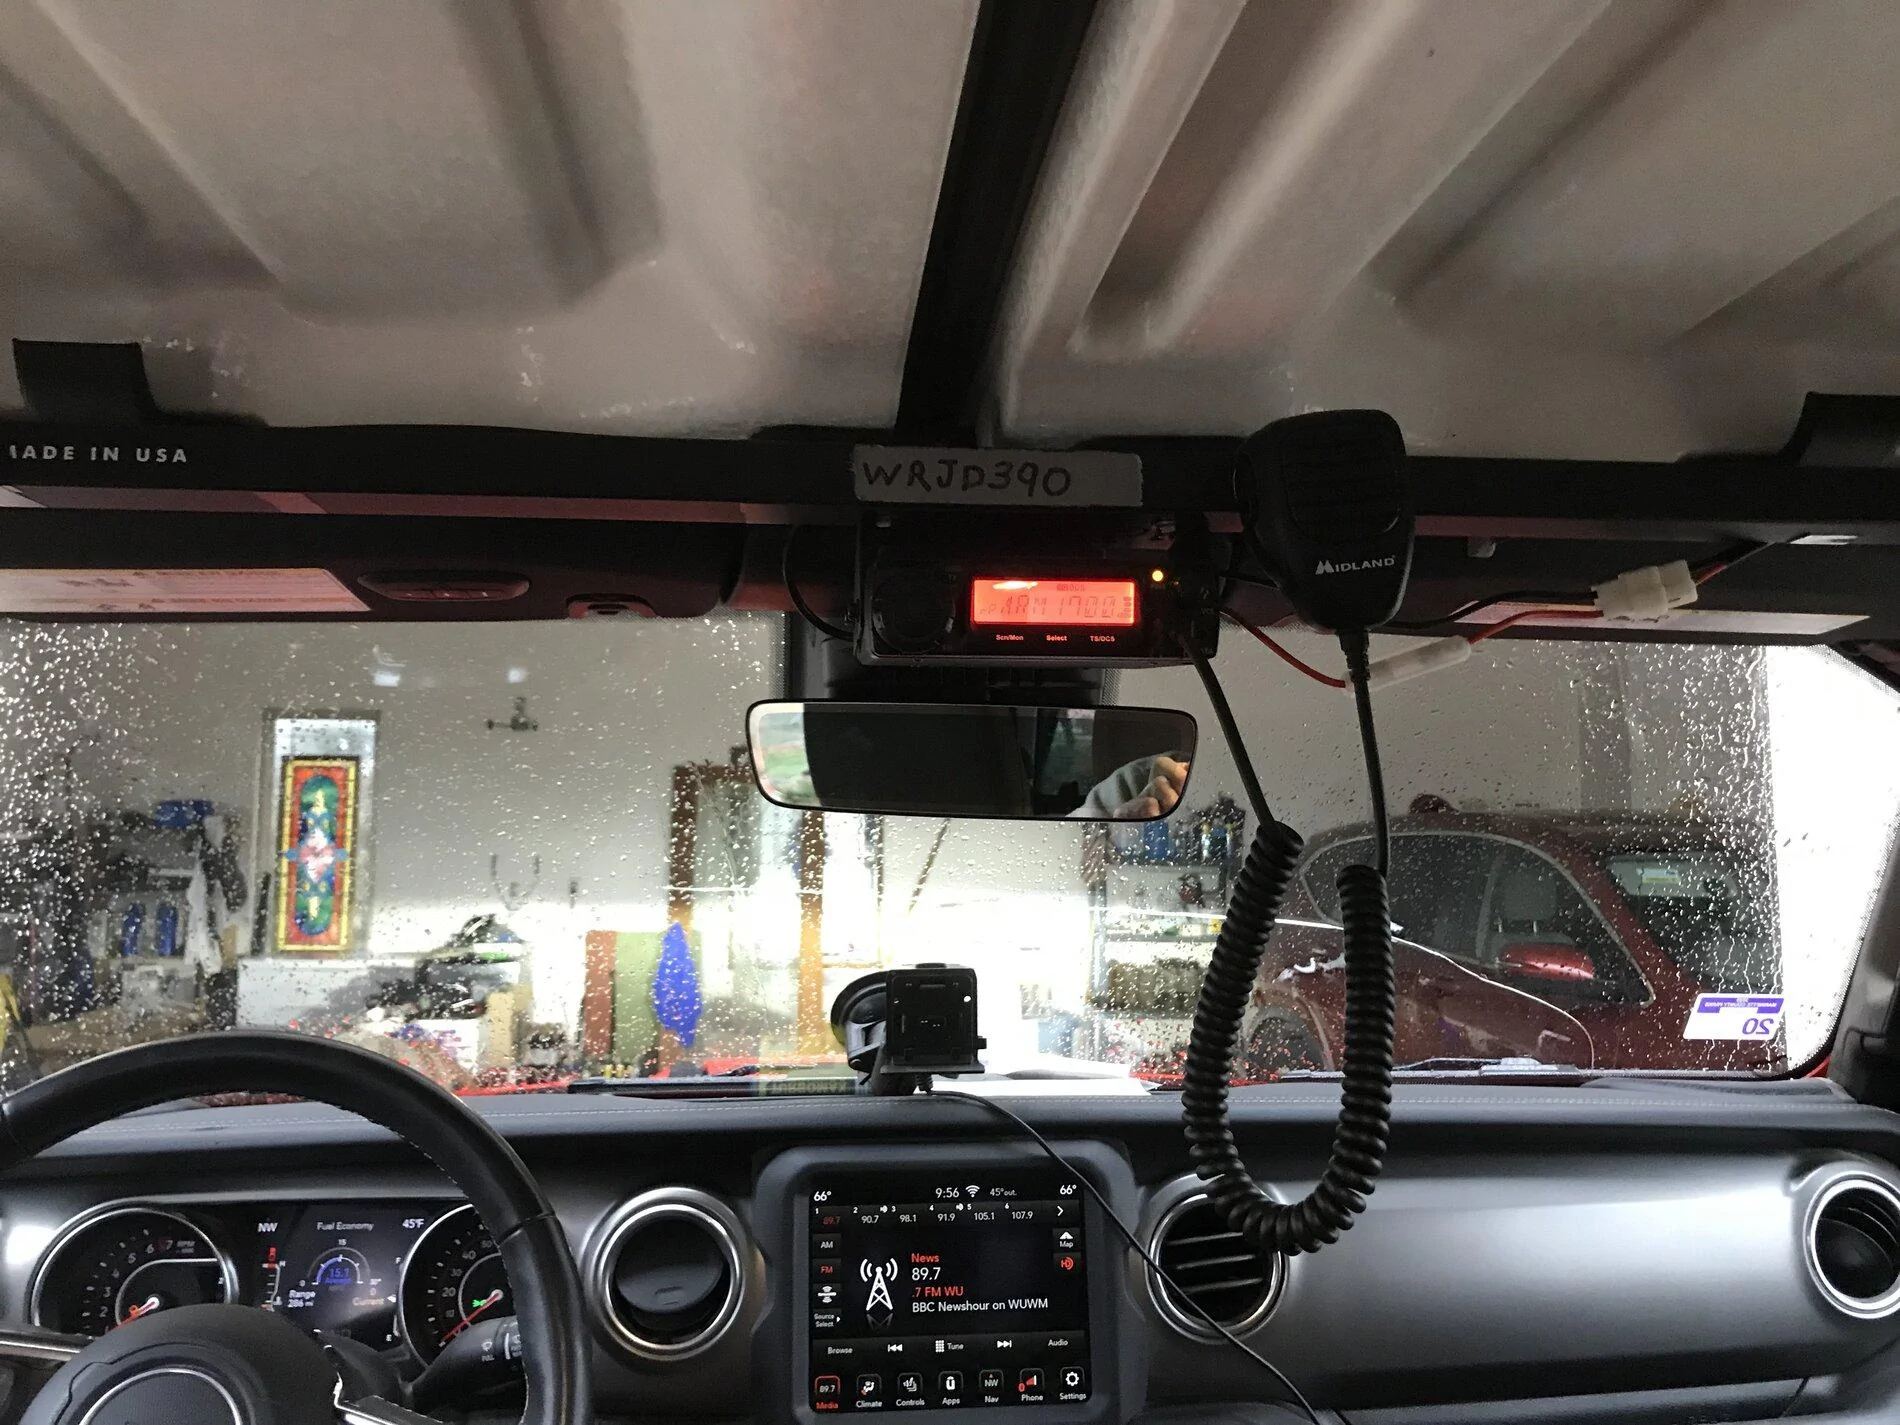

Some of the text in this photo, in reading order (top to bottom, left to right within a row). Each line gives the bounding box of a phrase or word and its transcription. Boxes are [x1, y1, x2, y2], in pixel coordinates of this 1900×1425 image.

[90, 446, 119, 461] IN
[136, 448, 187, 463] USA
[862, 459, 1072, 497] WRJD390
[1315, 555, 1396, 575] MIDLAND
[1046, 634, 1068, 642] Select
[935, 1187, 960, 1198] 9:56
[853, 1206, 858, 1214] 2
[891, 1205, 896, 1213] 3
[861, 1215, 880, 1224] 90.7
[899, 1214, 917, 1223] 98.1
[937, 1213, 956, 1222] 91.9
[973, 1212, 995, 1221] 105.1
[1011, 1211, 1034, 1220] 107.9
[258, 1222, 278, 1233] NW
[316, 1221, 375, 1232] Fuel Economy
[820, 1241, 834, 1249] AM
[1059, 1240, 1074, 1249] Map
[911, 1252, 940, 1264] News
[820, 1265, 834, 1274] FM
[911, 1267, 941, 1281] 89.7
[289, 1289, 316, 1300] Range
[441, 1287, 457, 1298] 20
[924, 1287, 942, 1298] FM
[944, 1286, 964, 1297] WU
[912, 1297, 1049, 1313] BBC Newshour on WUWM
[100, 1306, 109, 1318] 2
[813, 1313, 835, 1321] Source
[947, 1342, 964, 1350] Tune
[1048, 1338, 1069, 1347] Audio
[827, 1346, 853, 1355] Browse
[984, 1379, 999, 1387] NW
[819, 1384, 835, 1393] 89.7
[942, 1396, 960, 1405] Apps
[984, 1395, 999, 1403] Nav
[1021, 1393, 1044, 1401] Phone
[1059, 1391, 1087, 1401] Settings
[816, 1401, 839, 1410] Media
[856, 1400, 883, 1408] Climate
[896, 1398, 925, 1407] Controls
